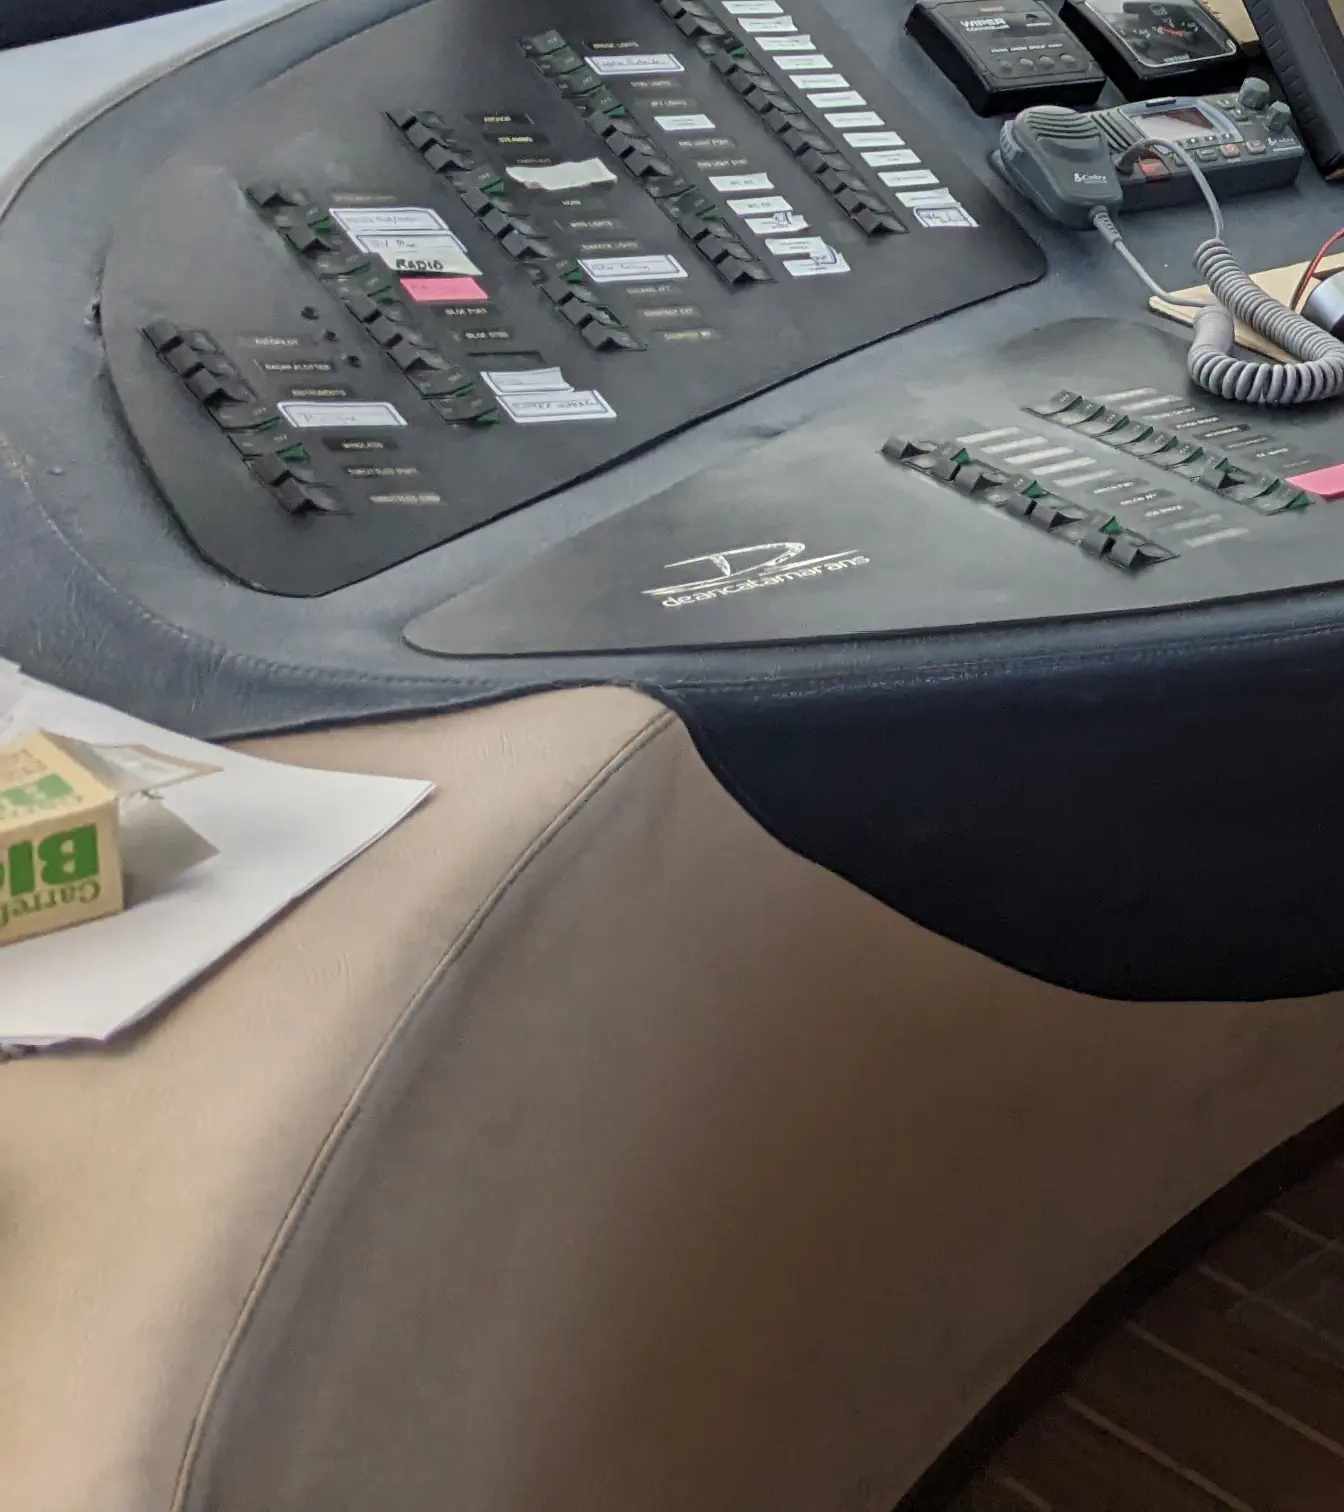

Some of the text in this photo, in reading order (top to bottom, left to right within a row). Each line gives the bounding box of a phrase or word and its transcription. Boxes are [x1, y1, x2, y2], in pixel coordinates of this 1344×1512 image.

[960, 18, 1006, 28] WIPER
[395, 258, 444, 271] RADIO
[0, 822, 100, 897] BI
